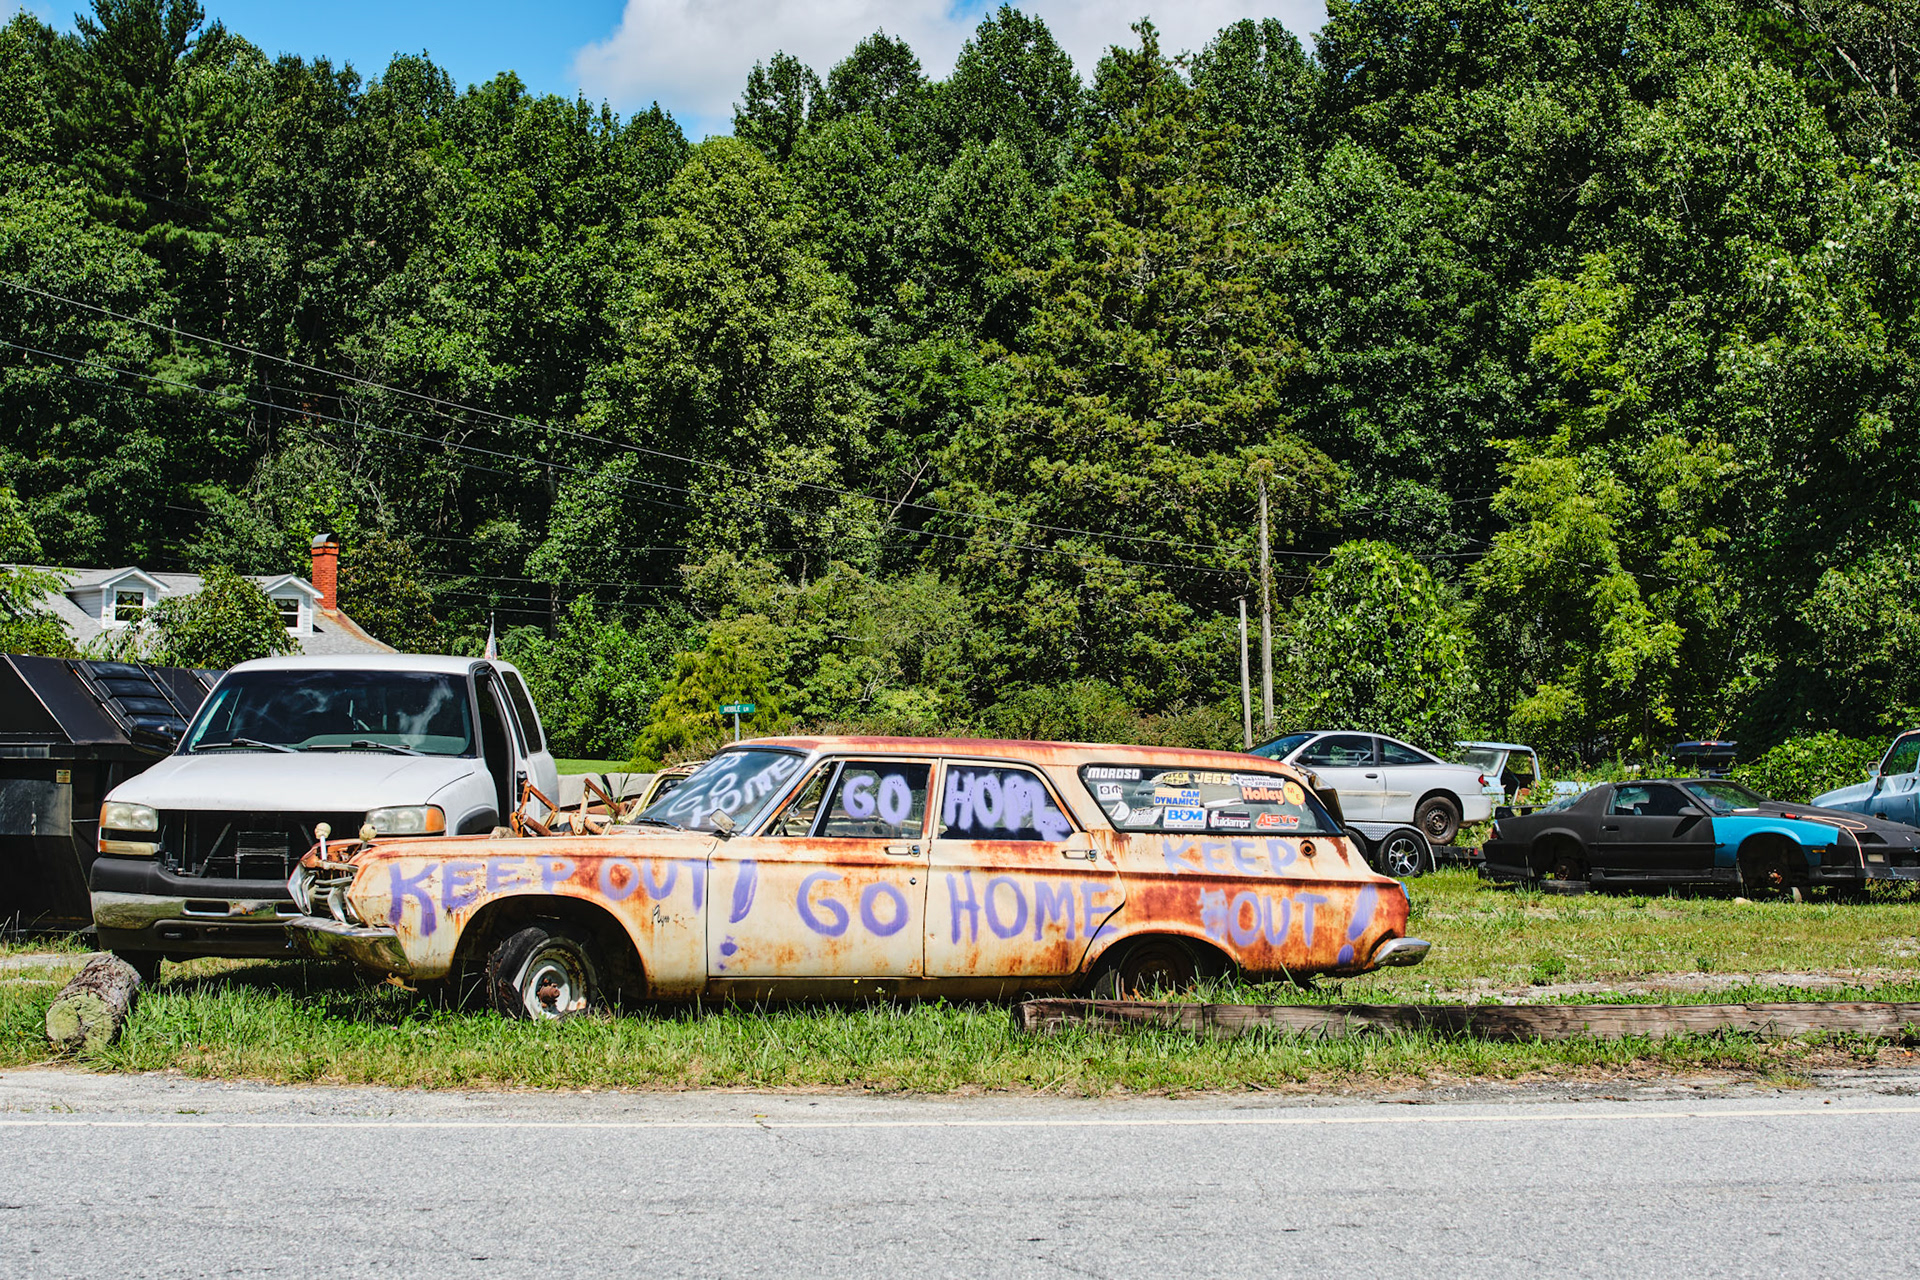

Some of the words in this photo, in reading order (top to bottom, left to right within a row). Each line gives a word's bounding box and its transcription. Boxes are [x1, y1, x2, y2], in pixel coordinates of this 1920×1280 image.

[1087, 768, 1141, 780] MOROSO
[1194, 772, 1231, 785] JEG'S
[690, 755, 803, 828] HOME
[1254, 780, 1283, 788] SPRINGS
[842, 773, 912, 827] GO
[1155, 796, 1200, 806] DYNAMICS
[1181, 790, 1200, 798] CAM
[1241, 787, 1285, 805] Holley
[1167, 809, 1203, 821] B&M
[1209, 811, 1251, 828] fluidampr
[1162, 838, 1298, 876] KEEP
[388, 856, 576, 938] KEEP
[796, 870, 909, 937] GO
[945, 870, 1120, 945] HOME
